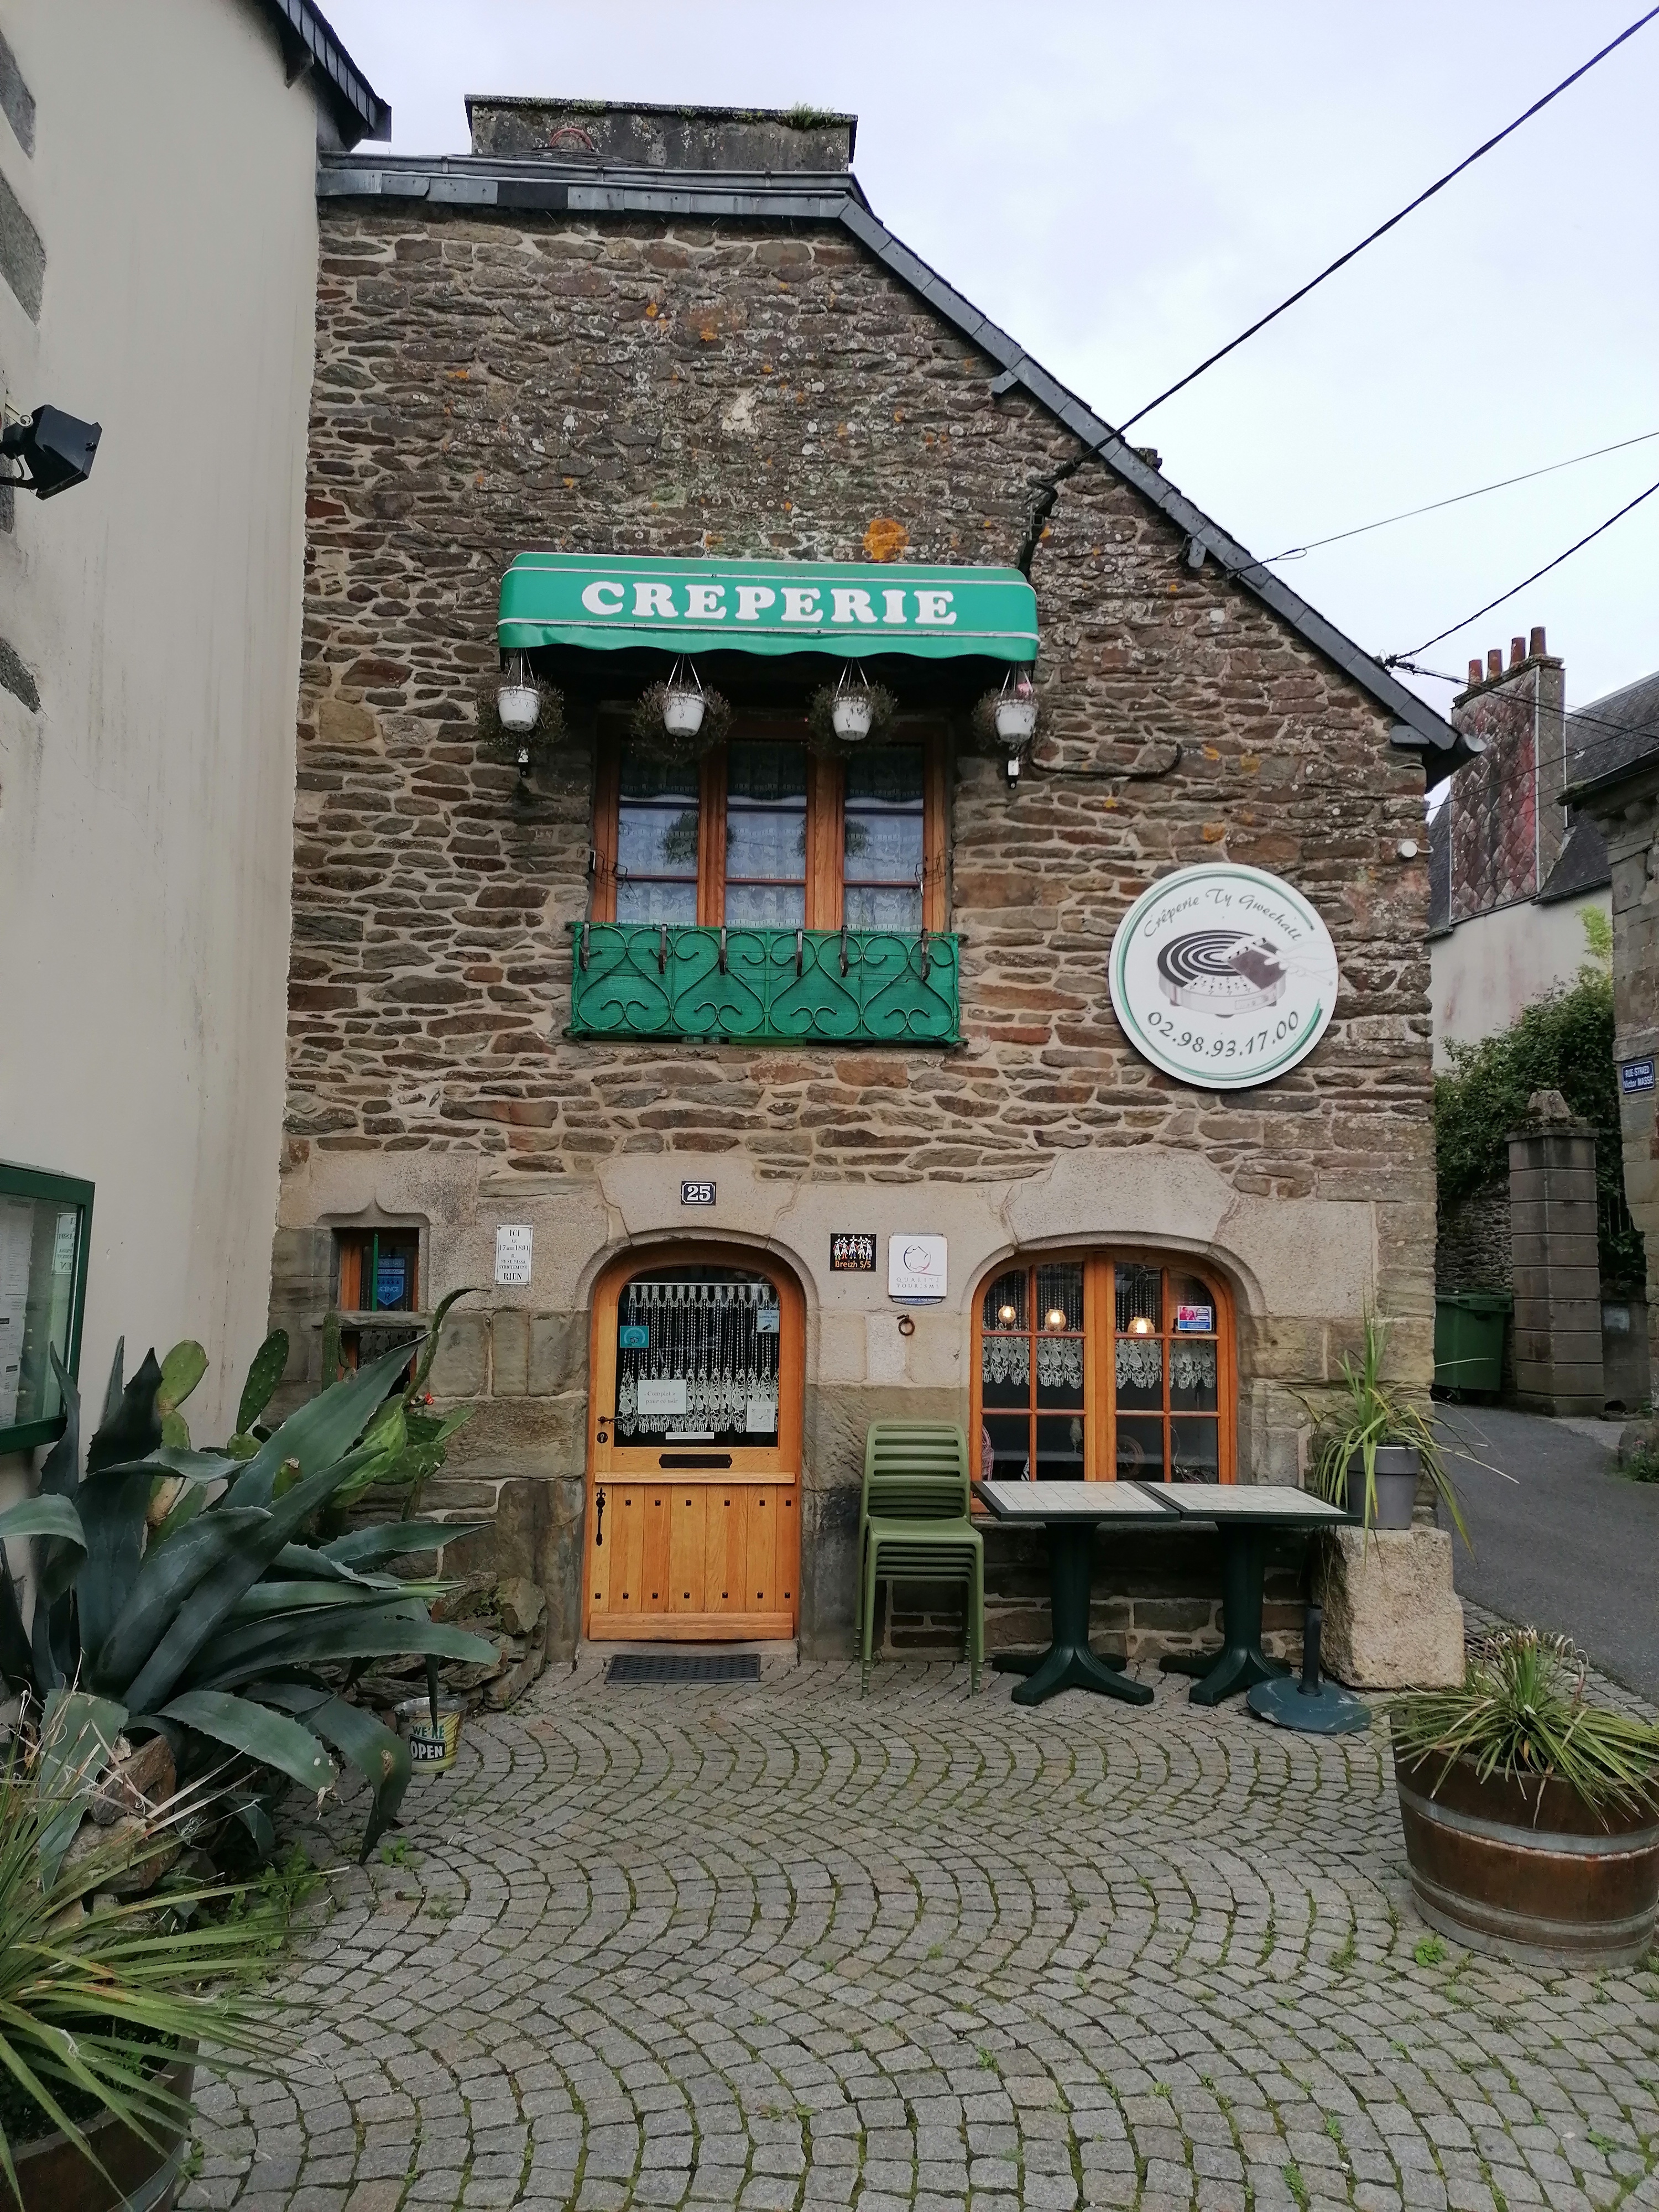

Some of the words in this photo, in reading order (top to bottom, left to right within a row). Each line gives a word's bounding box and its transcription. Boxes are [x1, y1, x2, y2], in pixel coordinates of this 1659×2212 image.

[581, 581, 957, 625] CREPERIE
[1144, 896, 1199, 938] Crêperie
[1205, 888, 1233, 907] Ty
[1239, 894, 1302, 941] Gwechall
[1147, 1011, 1298, 1057] 02.98.93.17.00
[687, 1185, 711, 1201] 25
[859, 1260, 872, 1269] 5/5
[410, 1741, 443, 1759] OPEN
